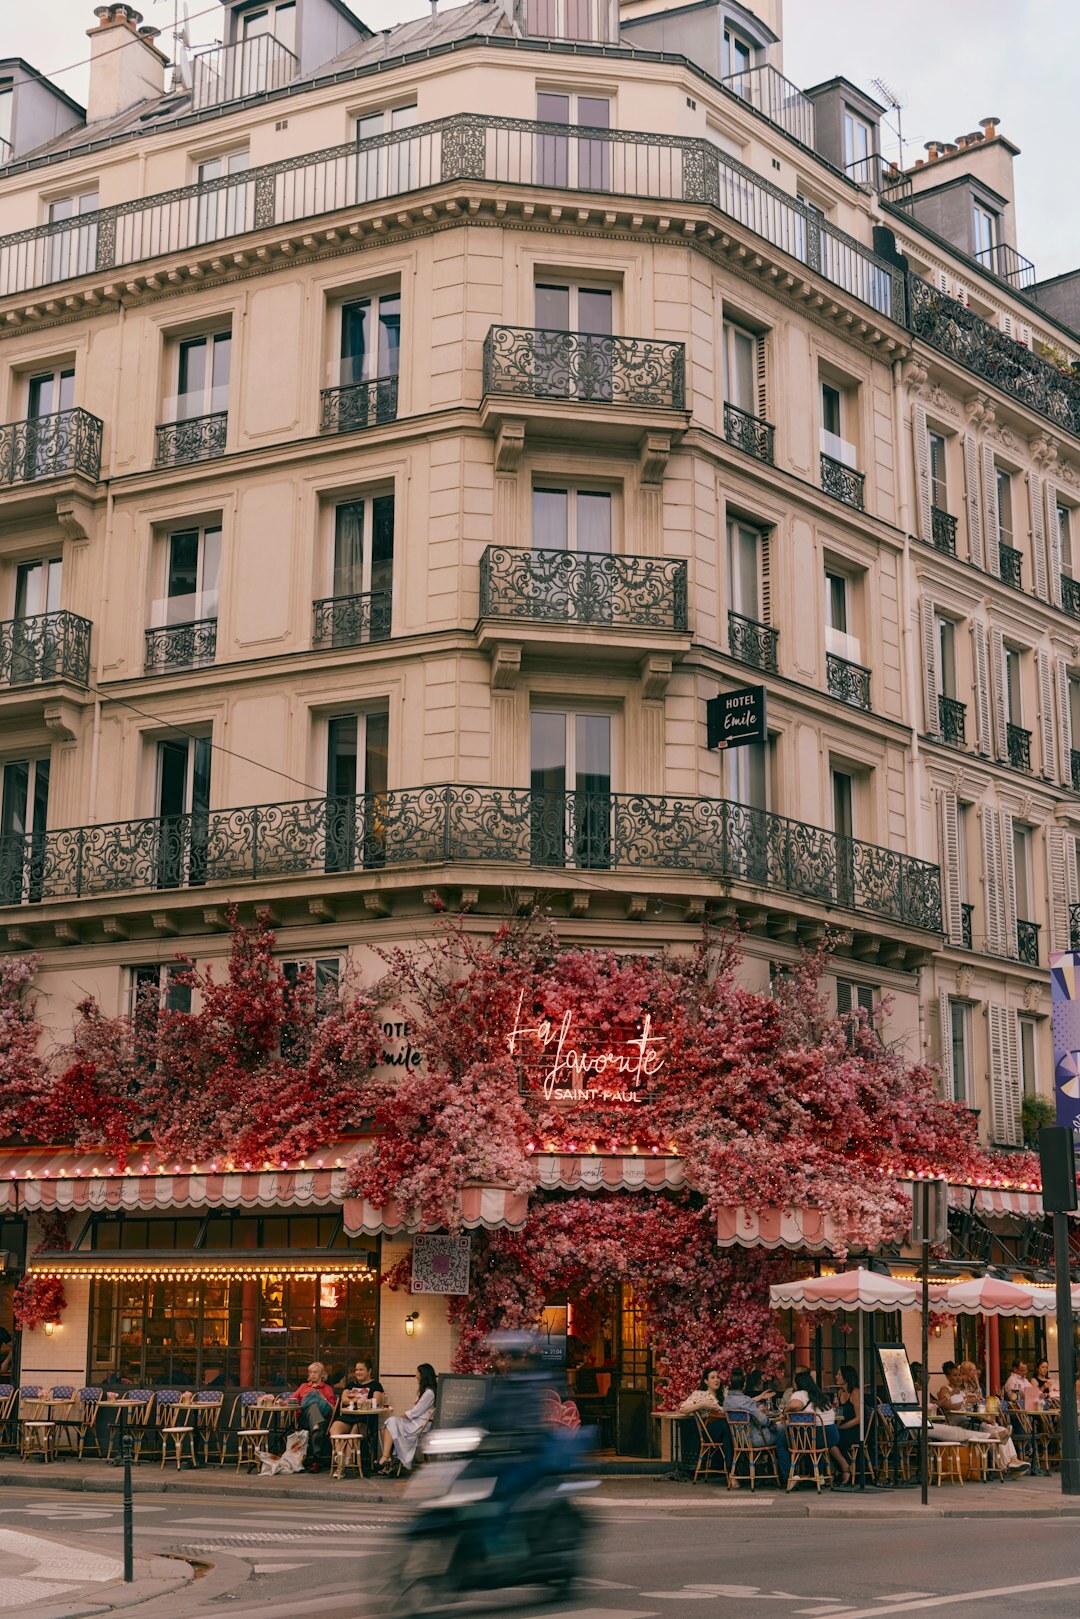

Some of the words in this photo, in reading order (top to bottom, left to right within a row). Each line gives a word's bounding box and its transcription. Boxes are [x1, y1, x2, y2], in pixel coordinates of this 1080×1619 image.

[726, 695, 755, 709] HOTEL
[724, 710, 757, 729] Emile
[378, 1022, 416, 1037] OTE
[369, 1042, 422, 1068] mile
[544, 1010, 667, 1100] favorite
[554, 1088, 642, 1102] SAINT-PAUL
[568, 1160, 607, 1183] favorite
